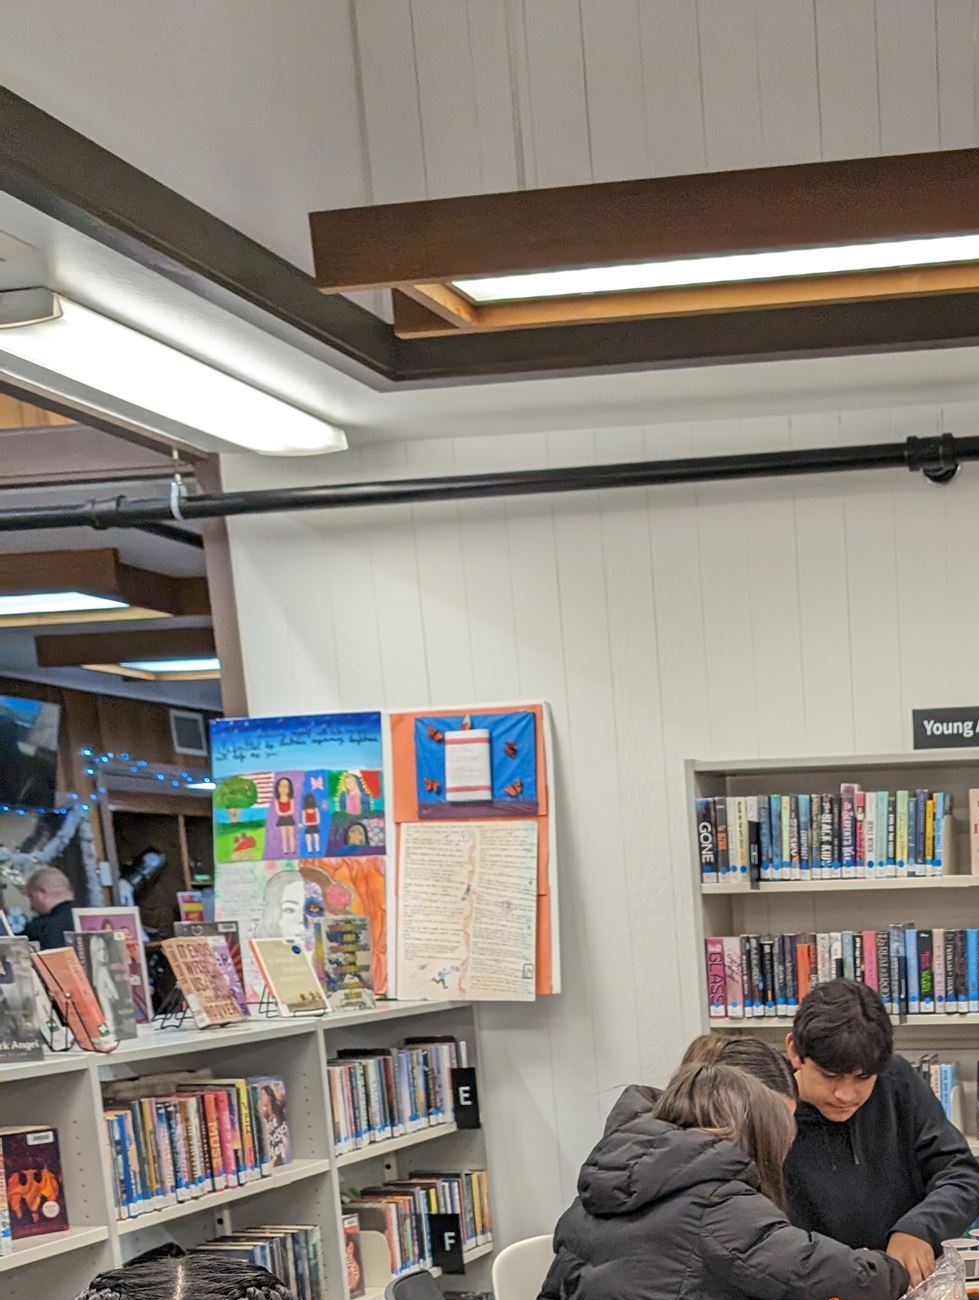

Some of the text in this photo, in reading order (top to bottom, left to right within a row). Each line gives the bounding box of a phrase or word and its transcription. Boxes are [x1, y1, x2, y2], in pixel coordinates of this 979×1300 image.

[923, 719, 974, 738] Young
[700, 822, 714, 863] GONE
[458, 1086, 472, 1106] E
[443, 1231, 456, 1251] F
